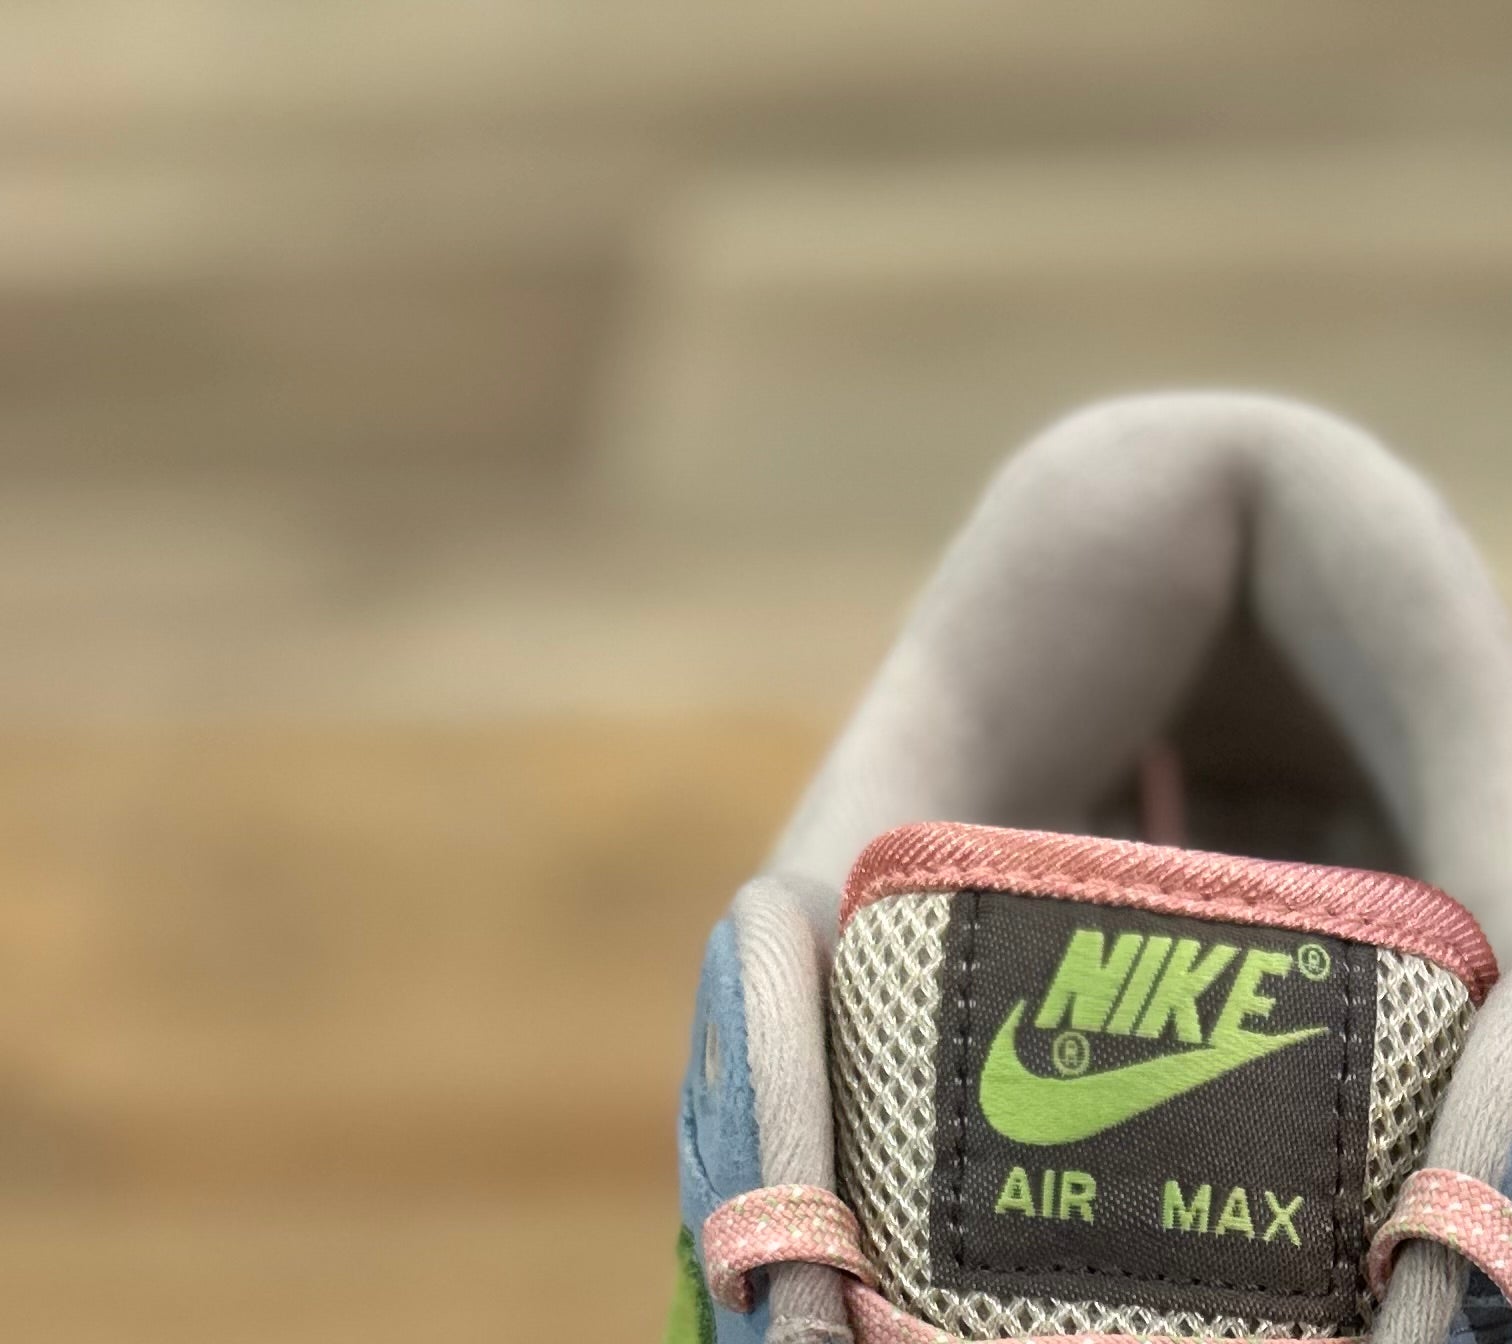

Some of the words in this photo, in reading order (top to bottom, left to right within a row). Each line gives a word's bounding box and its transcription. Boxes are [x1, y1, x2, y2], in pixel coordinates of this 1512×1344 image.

[1034, 929, 1293, 1049] NIKE
[995, 1166, 1098, 1226] AIR
[1160, 1180, 1305, 1249] MAX
